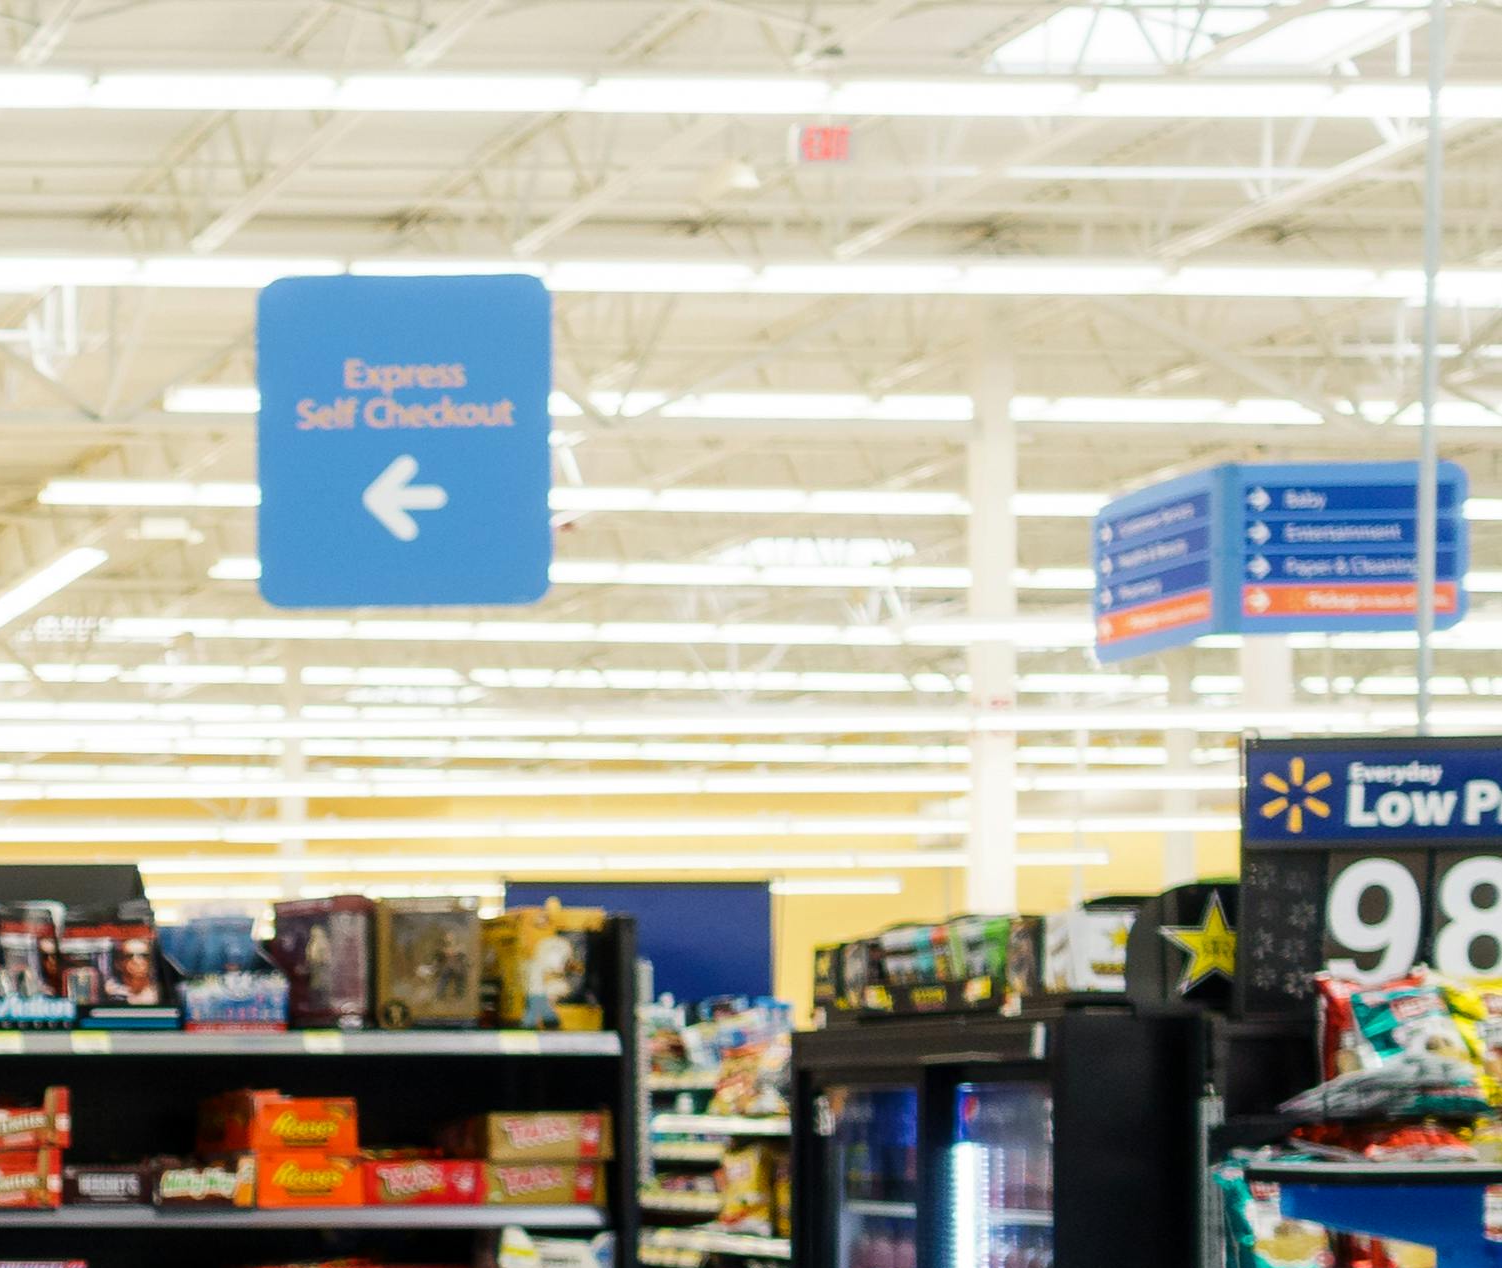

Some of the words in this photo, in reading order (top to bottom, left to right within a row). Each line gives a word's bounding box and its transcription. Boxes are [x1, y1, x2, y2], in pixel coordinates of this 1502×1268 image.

[343, 358, 468, 396] Express
[296, 396, 359, 431] Self
[363, 396, 516, 430] Checkout
[1349, 761, 1442, 786] Everyday
[1346, 783, 1458, 828] Low
[1462, 781, 1502, 827] P
[1324, 856, 1502, 987] 98
